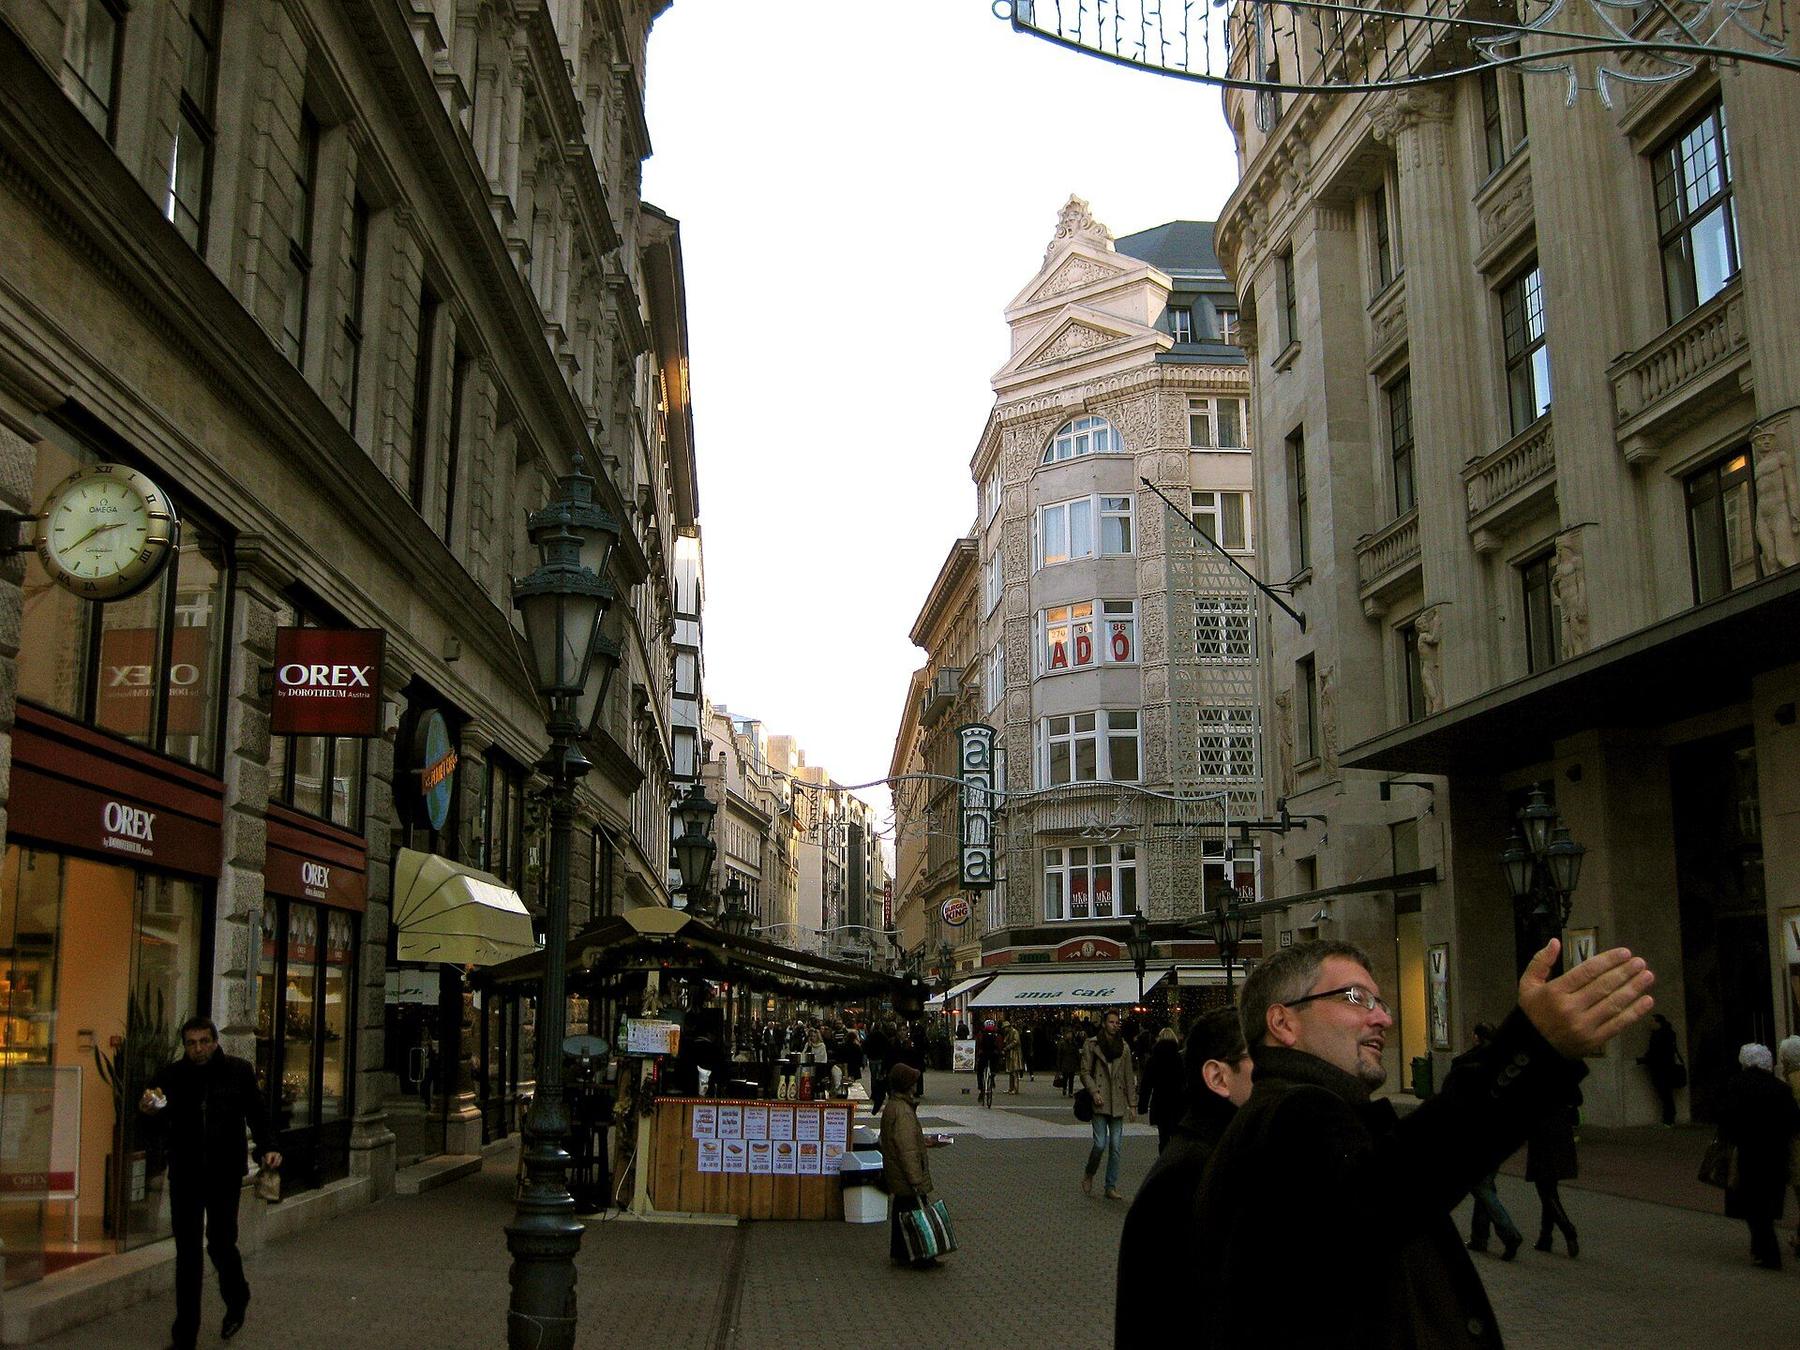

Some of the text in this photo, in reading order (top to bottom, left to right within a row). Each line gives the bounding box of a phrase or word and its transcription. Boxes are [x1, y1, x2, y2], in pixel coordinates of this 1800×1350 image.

[1051, 630, 1066, 639] 270
[1112, 623, 1127, 631] 86
[279, 664, 370, 687] OREX
[288, 688, 346, 698] DOROTHEUM
[965, 739, 990, 881] anna
[104, 801, 157, 841] OREX
[302, 861, 330, 889] OREX
[1096, 890, 1111, 903] MKB
[944, 902, 967, 914] BURGER
[945, 907, 968, 920] KING
[1014, 987, 1116, 999] anna café
